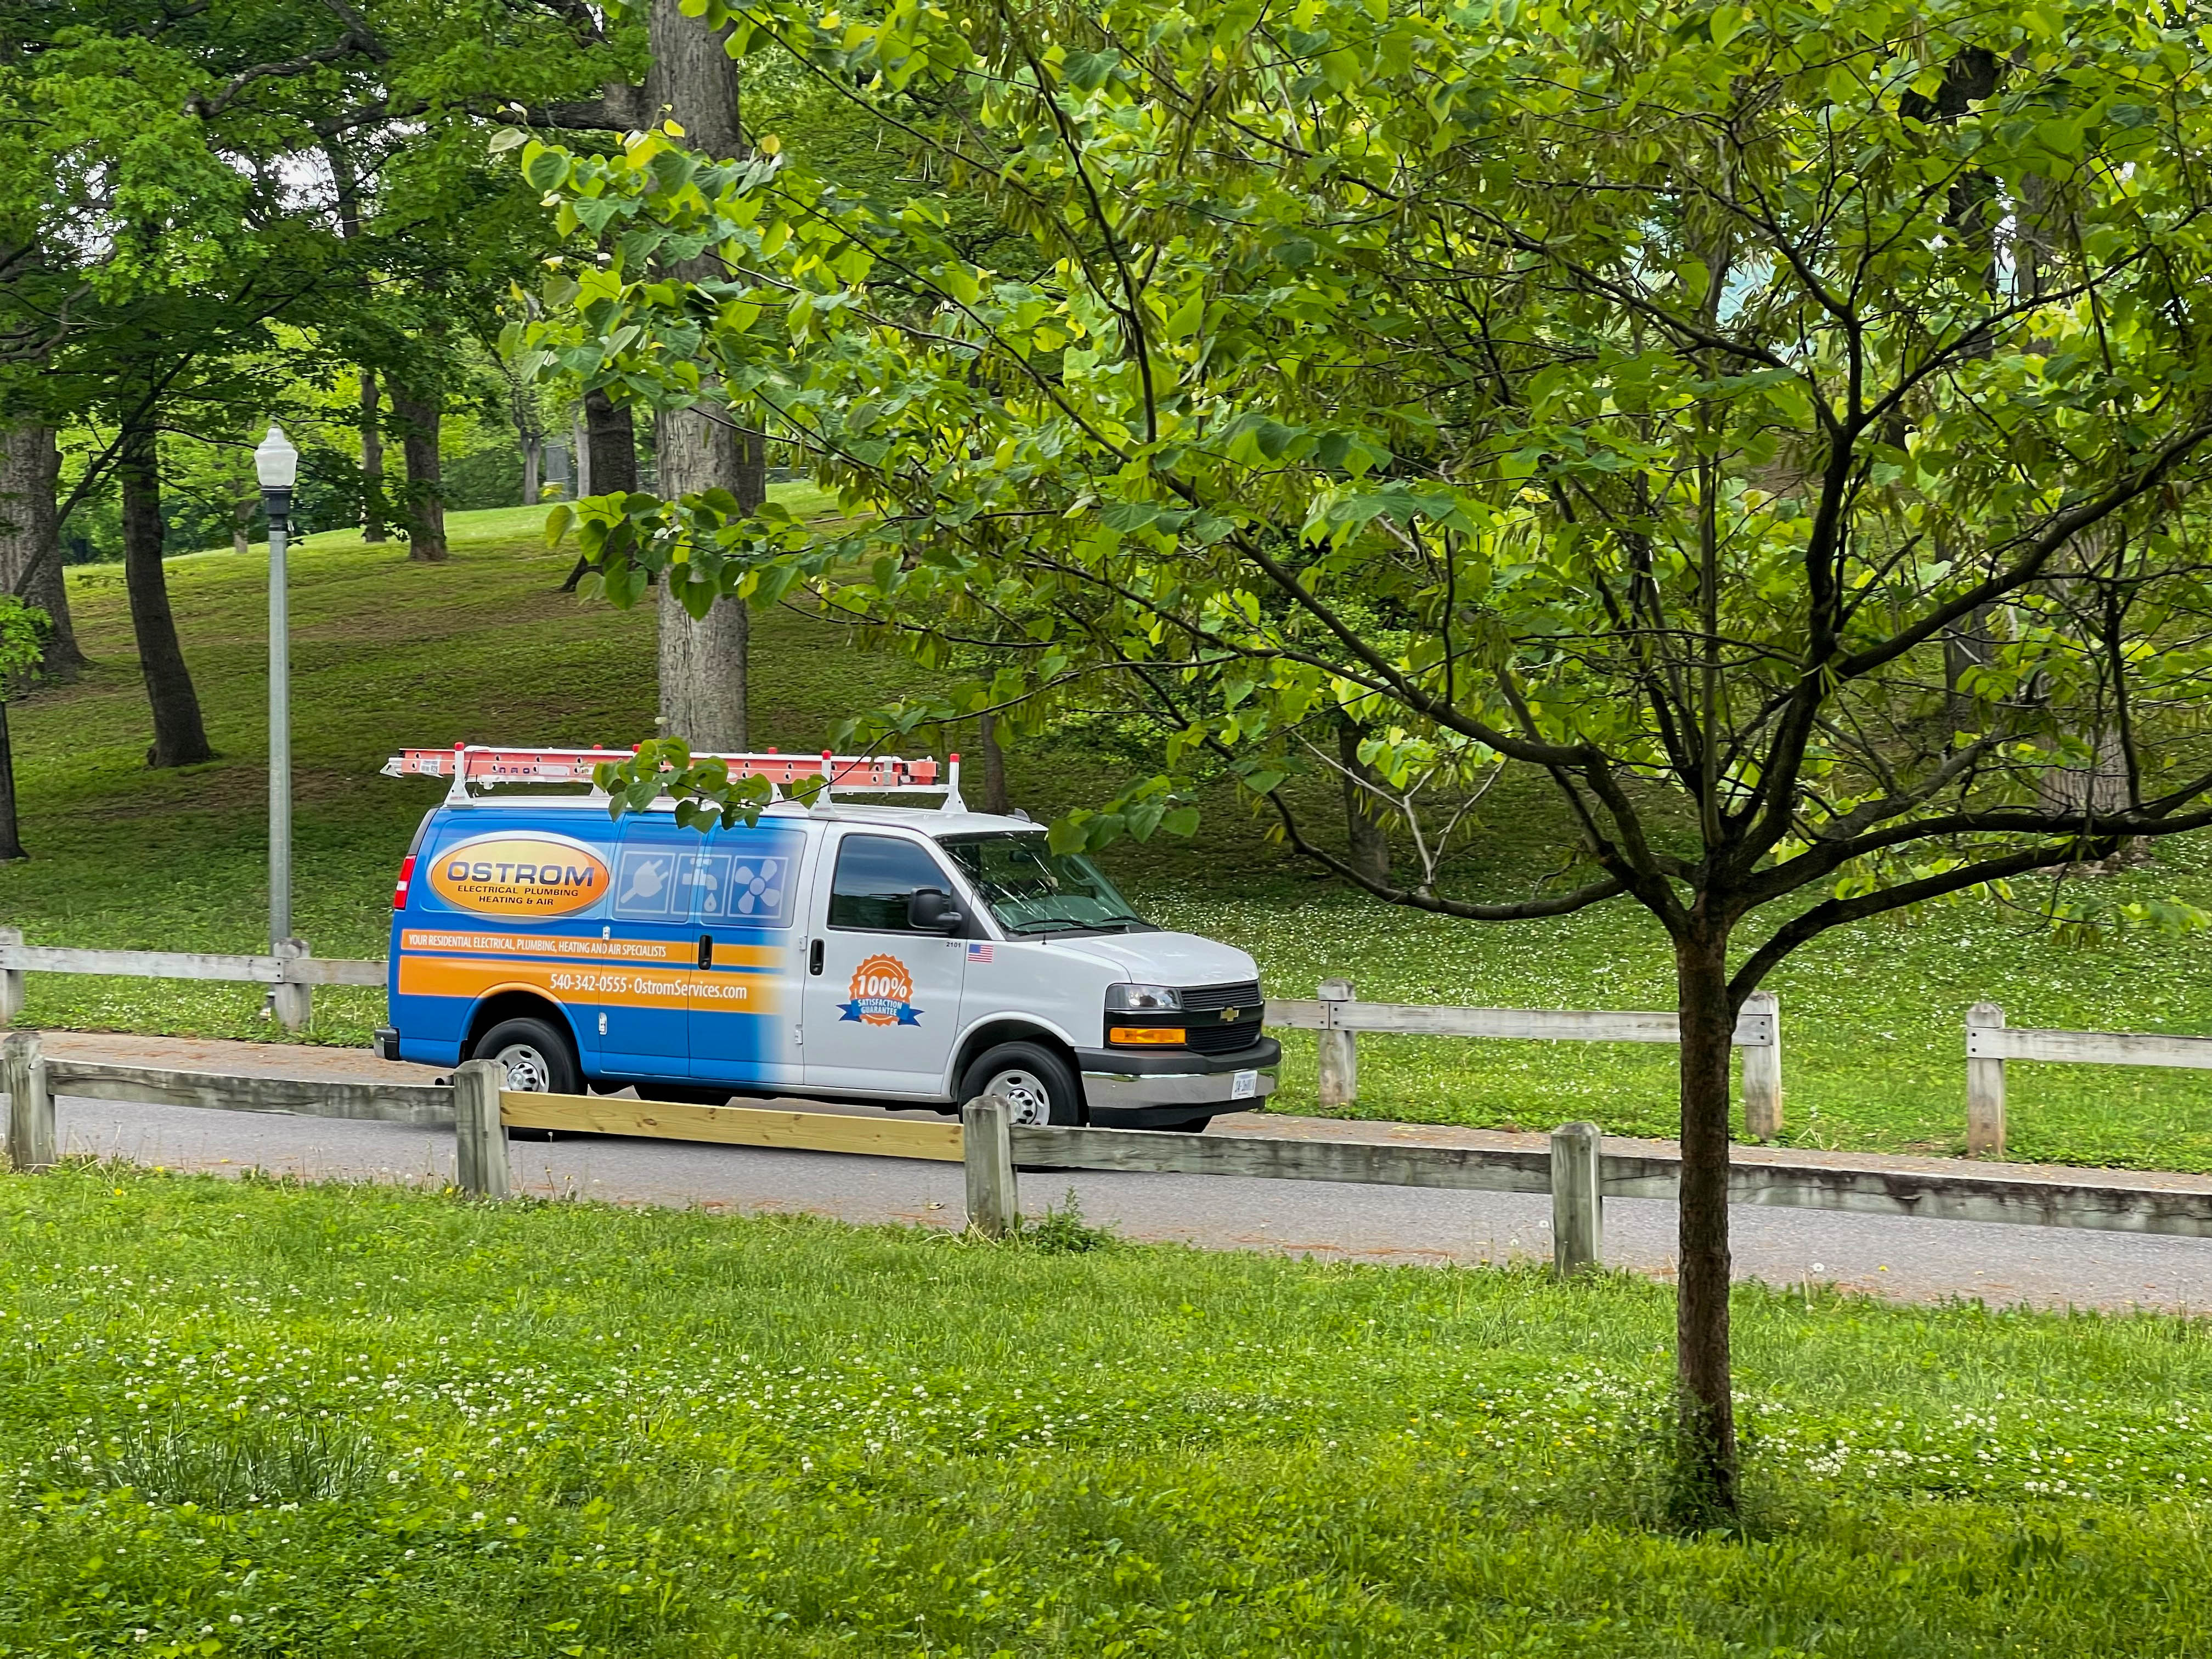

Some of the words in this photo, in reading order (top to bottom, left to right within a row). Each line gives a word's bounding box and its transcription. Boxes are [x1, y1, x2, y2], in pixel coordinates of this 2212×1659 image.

[447, 861, 595, 887] OSTROM
[458, 885, 518, 894] ELECTRICAL
[524, 888, 579, 896] PLUMBING
[479, 896, 523, 904] HEATING
[409, 934, 428, 945] YOUR
[429, 935, 472, 948] RESIDENTIAL
[473, 937, 516, 951] ELECTRICAL,
[517, 939, 557, 953] PLUMBING,
[558, 941, 590, 953] HEATING
[591, 943, 607, 954] AND
[608, 944, 622, 955] AIR
[622, 945, 667, 957] SPECIALISTS
[550, 973, 627, 993] 540-342-0555
[634, 978, 747, 1000] OstromServices.com
[857, 975, 907, 998] 100%
[857, 998, 902, 1010] SATISFACTION
[860, 1006, 898, 1016] GUARANTEE
